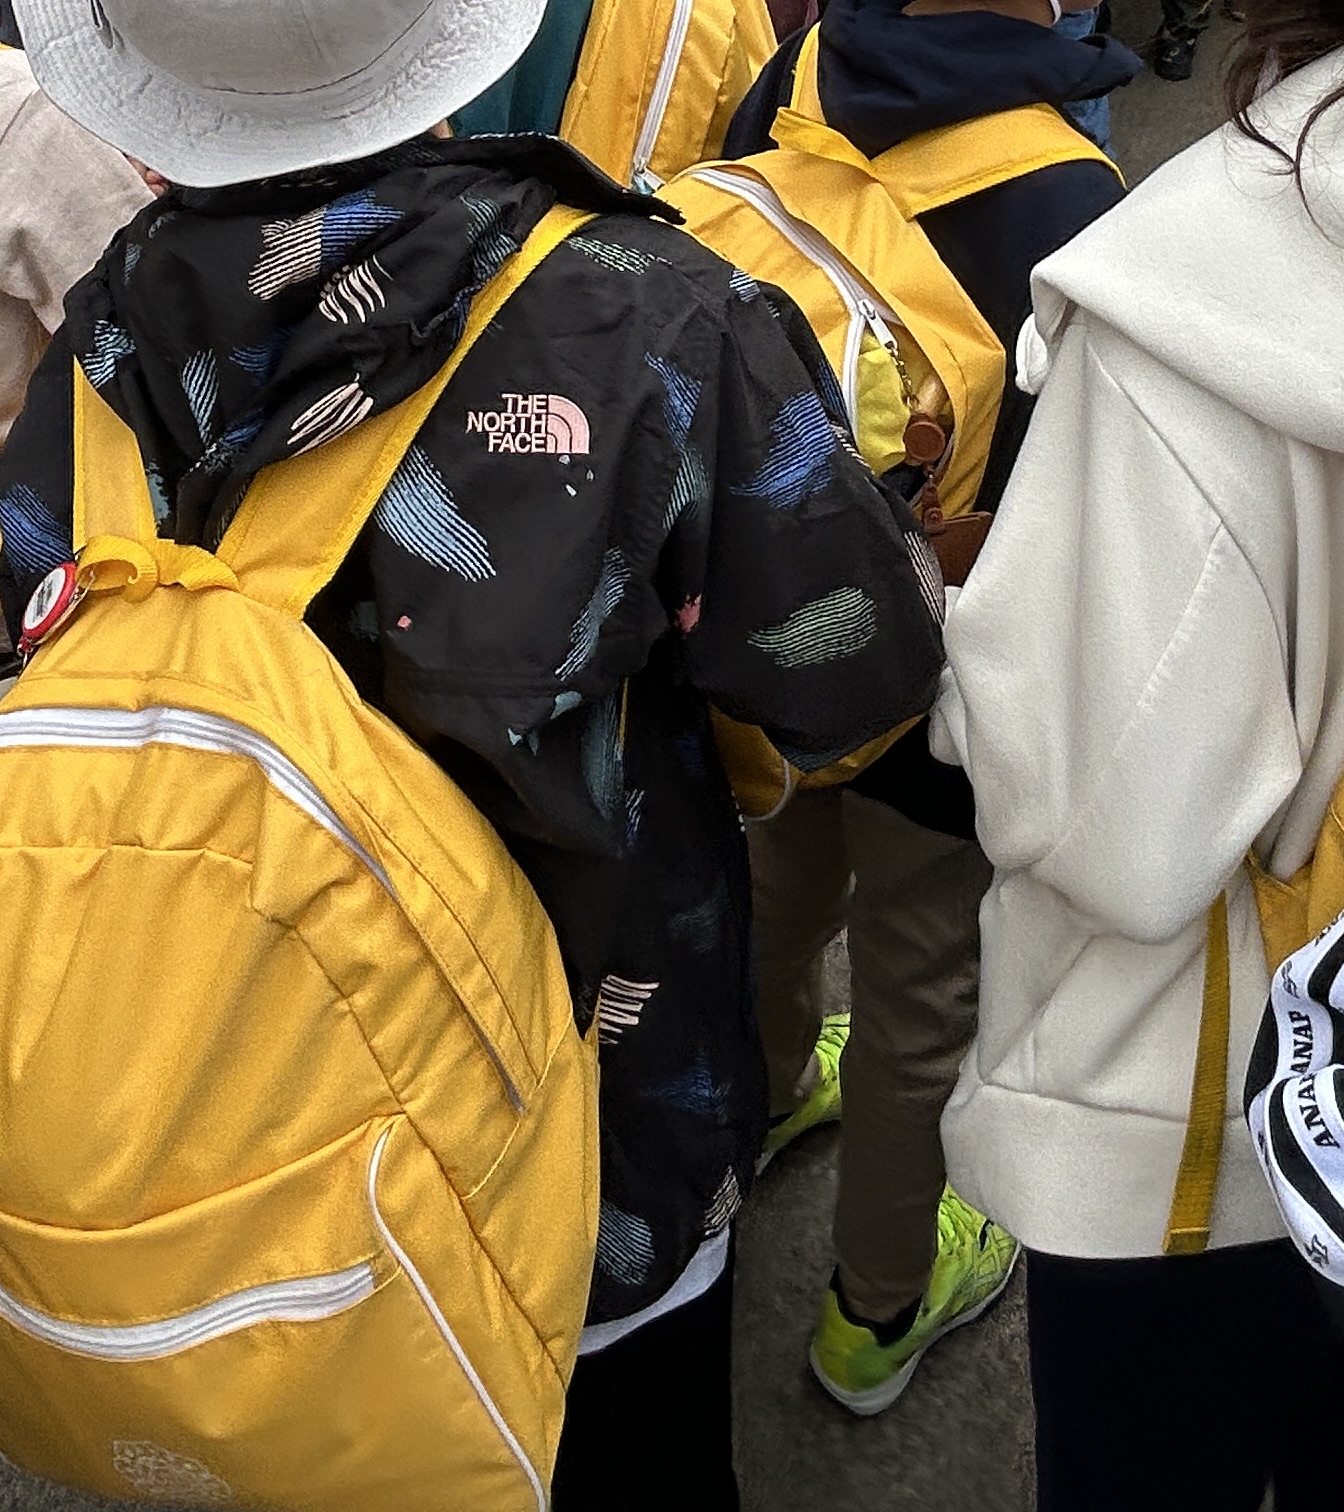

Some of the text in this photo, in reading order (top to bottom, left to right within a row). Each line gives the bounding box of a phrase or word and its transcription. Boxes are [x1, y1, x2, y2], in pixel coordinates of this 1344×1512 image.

[502, 394, 547, 414] THE
[466, 412, 546, 434] NORTH
[488, 433, 547, 453] FACE
